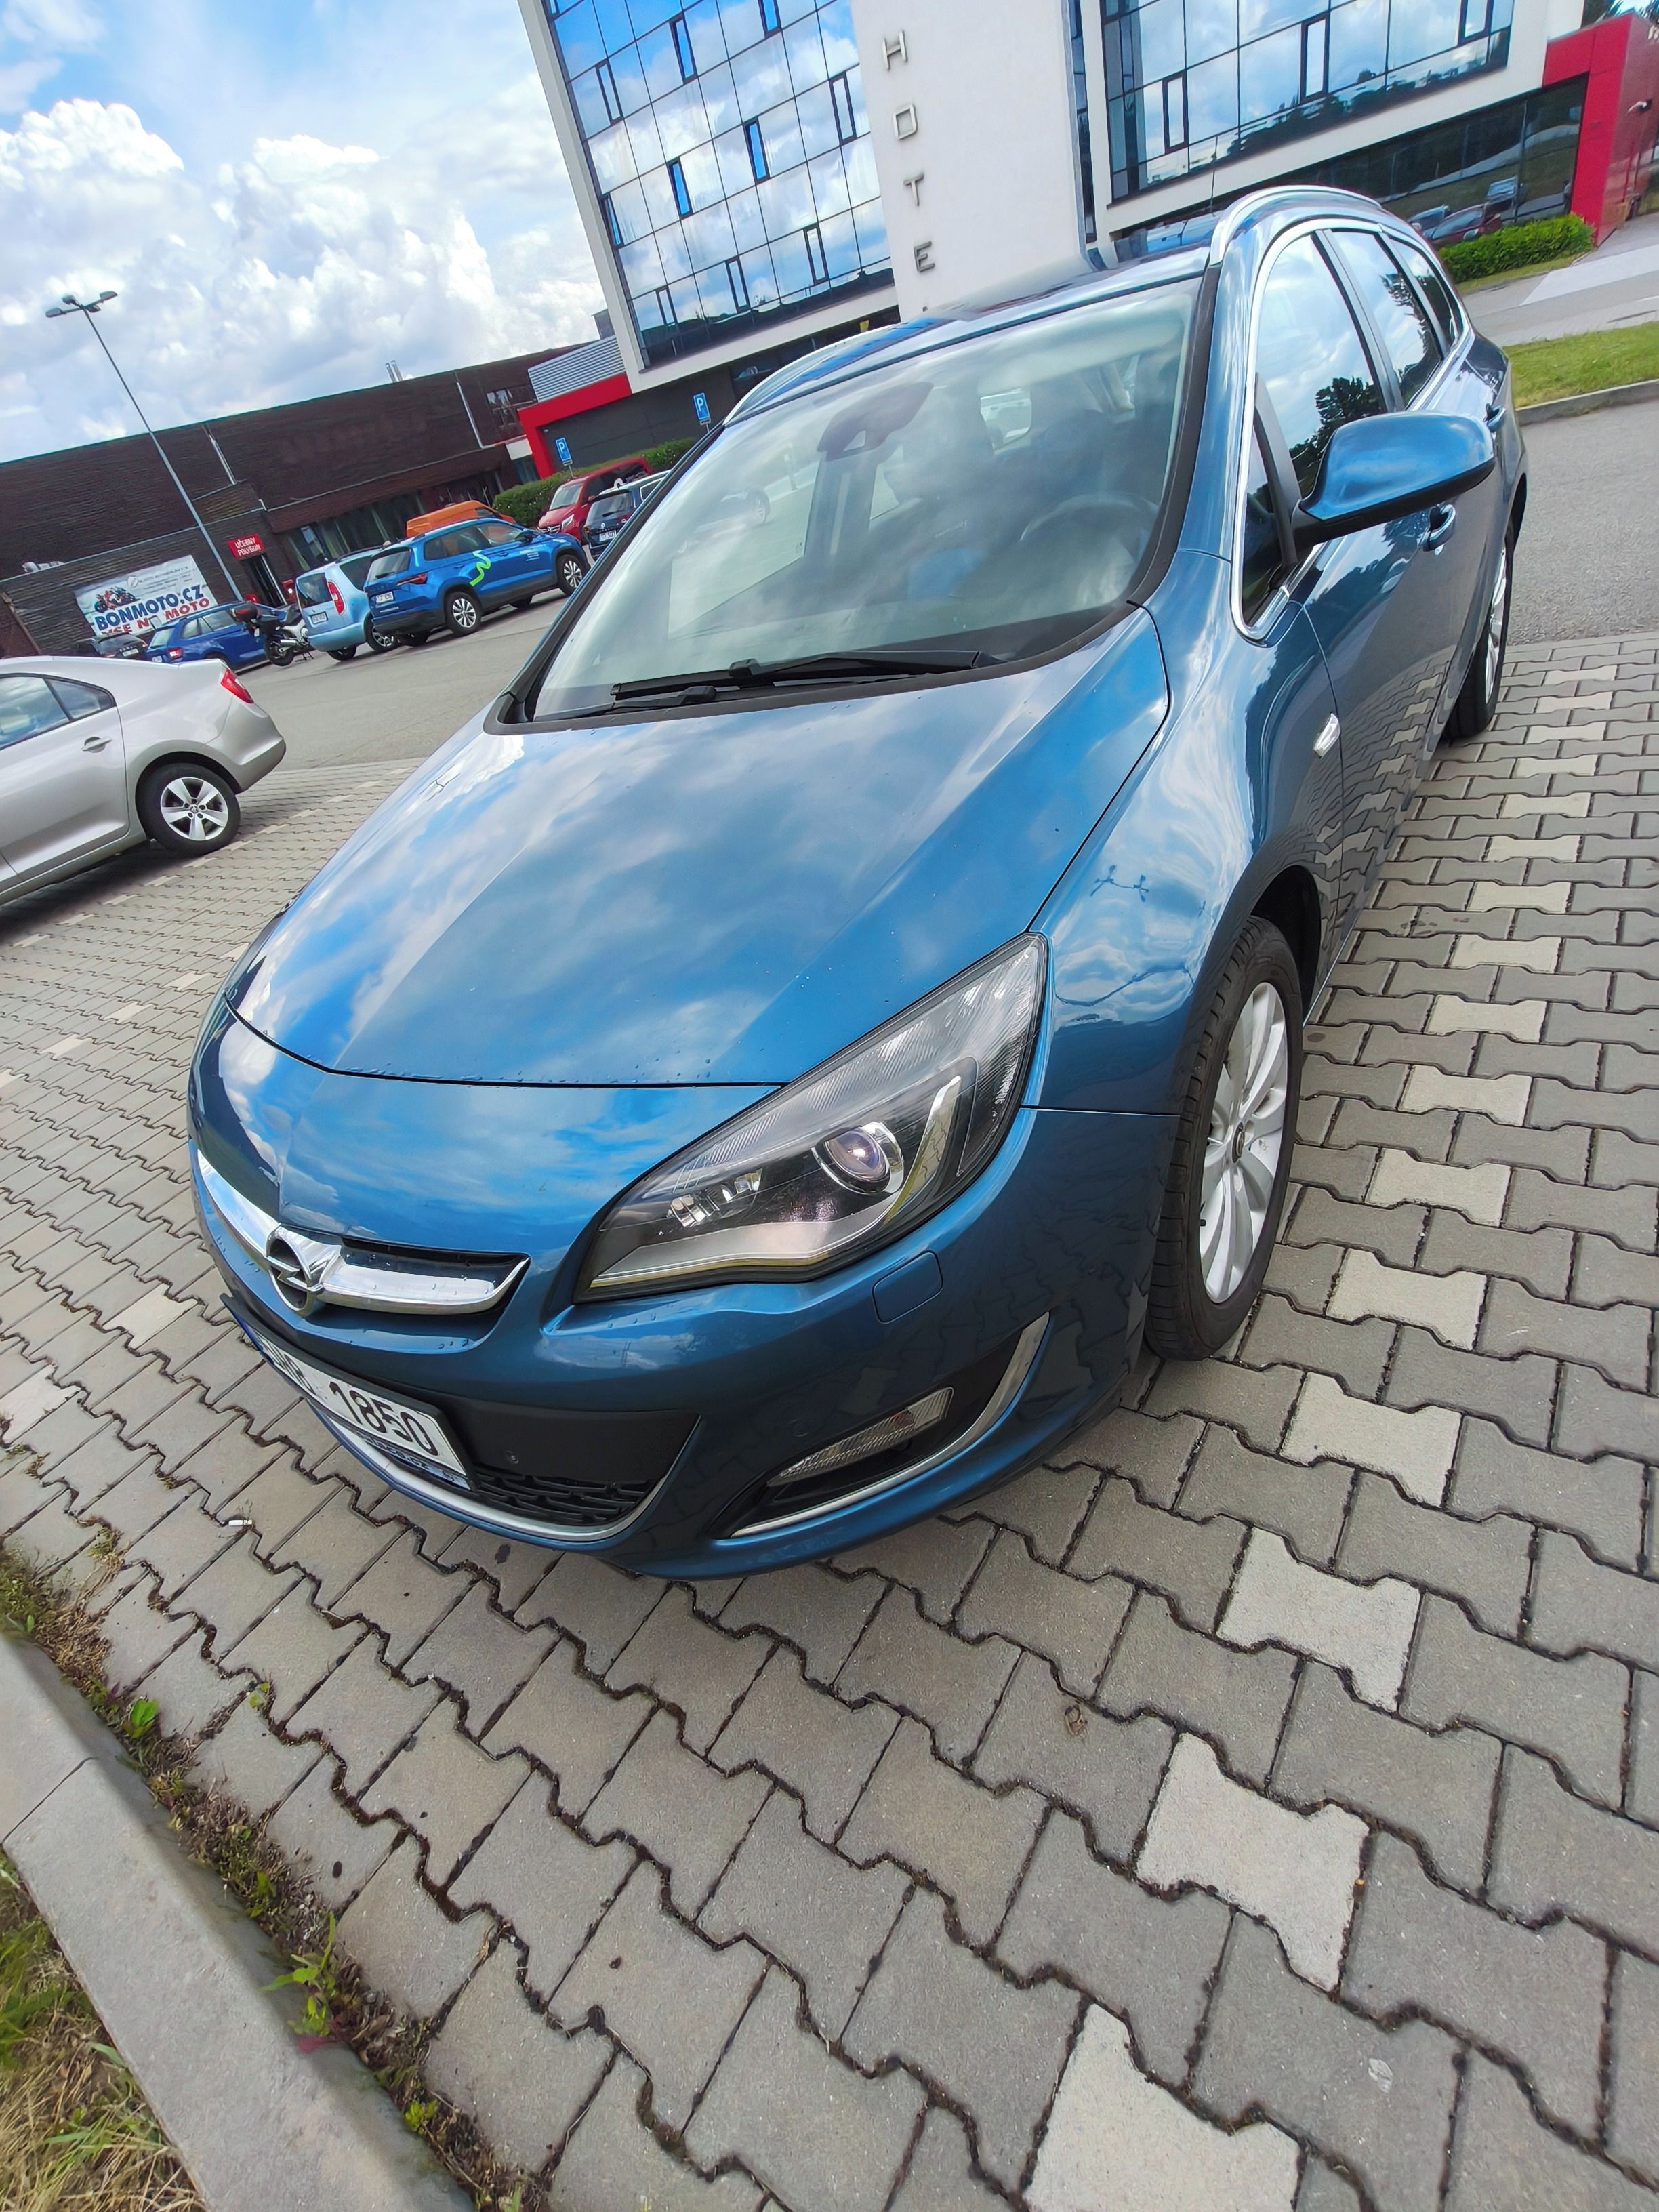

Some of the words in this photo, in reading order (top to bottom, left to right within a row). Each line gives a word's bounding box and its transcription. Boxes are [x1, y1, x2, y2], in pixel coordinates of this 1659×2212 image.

[882, 29, 936, 312] HOTE
[697, 397, 704, 412] P
[558, 441, 565, 454] P
[237, 544, 262, 556] POLYGON
[94, 584, 204, 631] BONMOTO.CZ
[164, 598, 210, 620] MOTO
[329, 1381, 439, 1456] 1850
